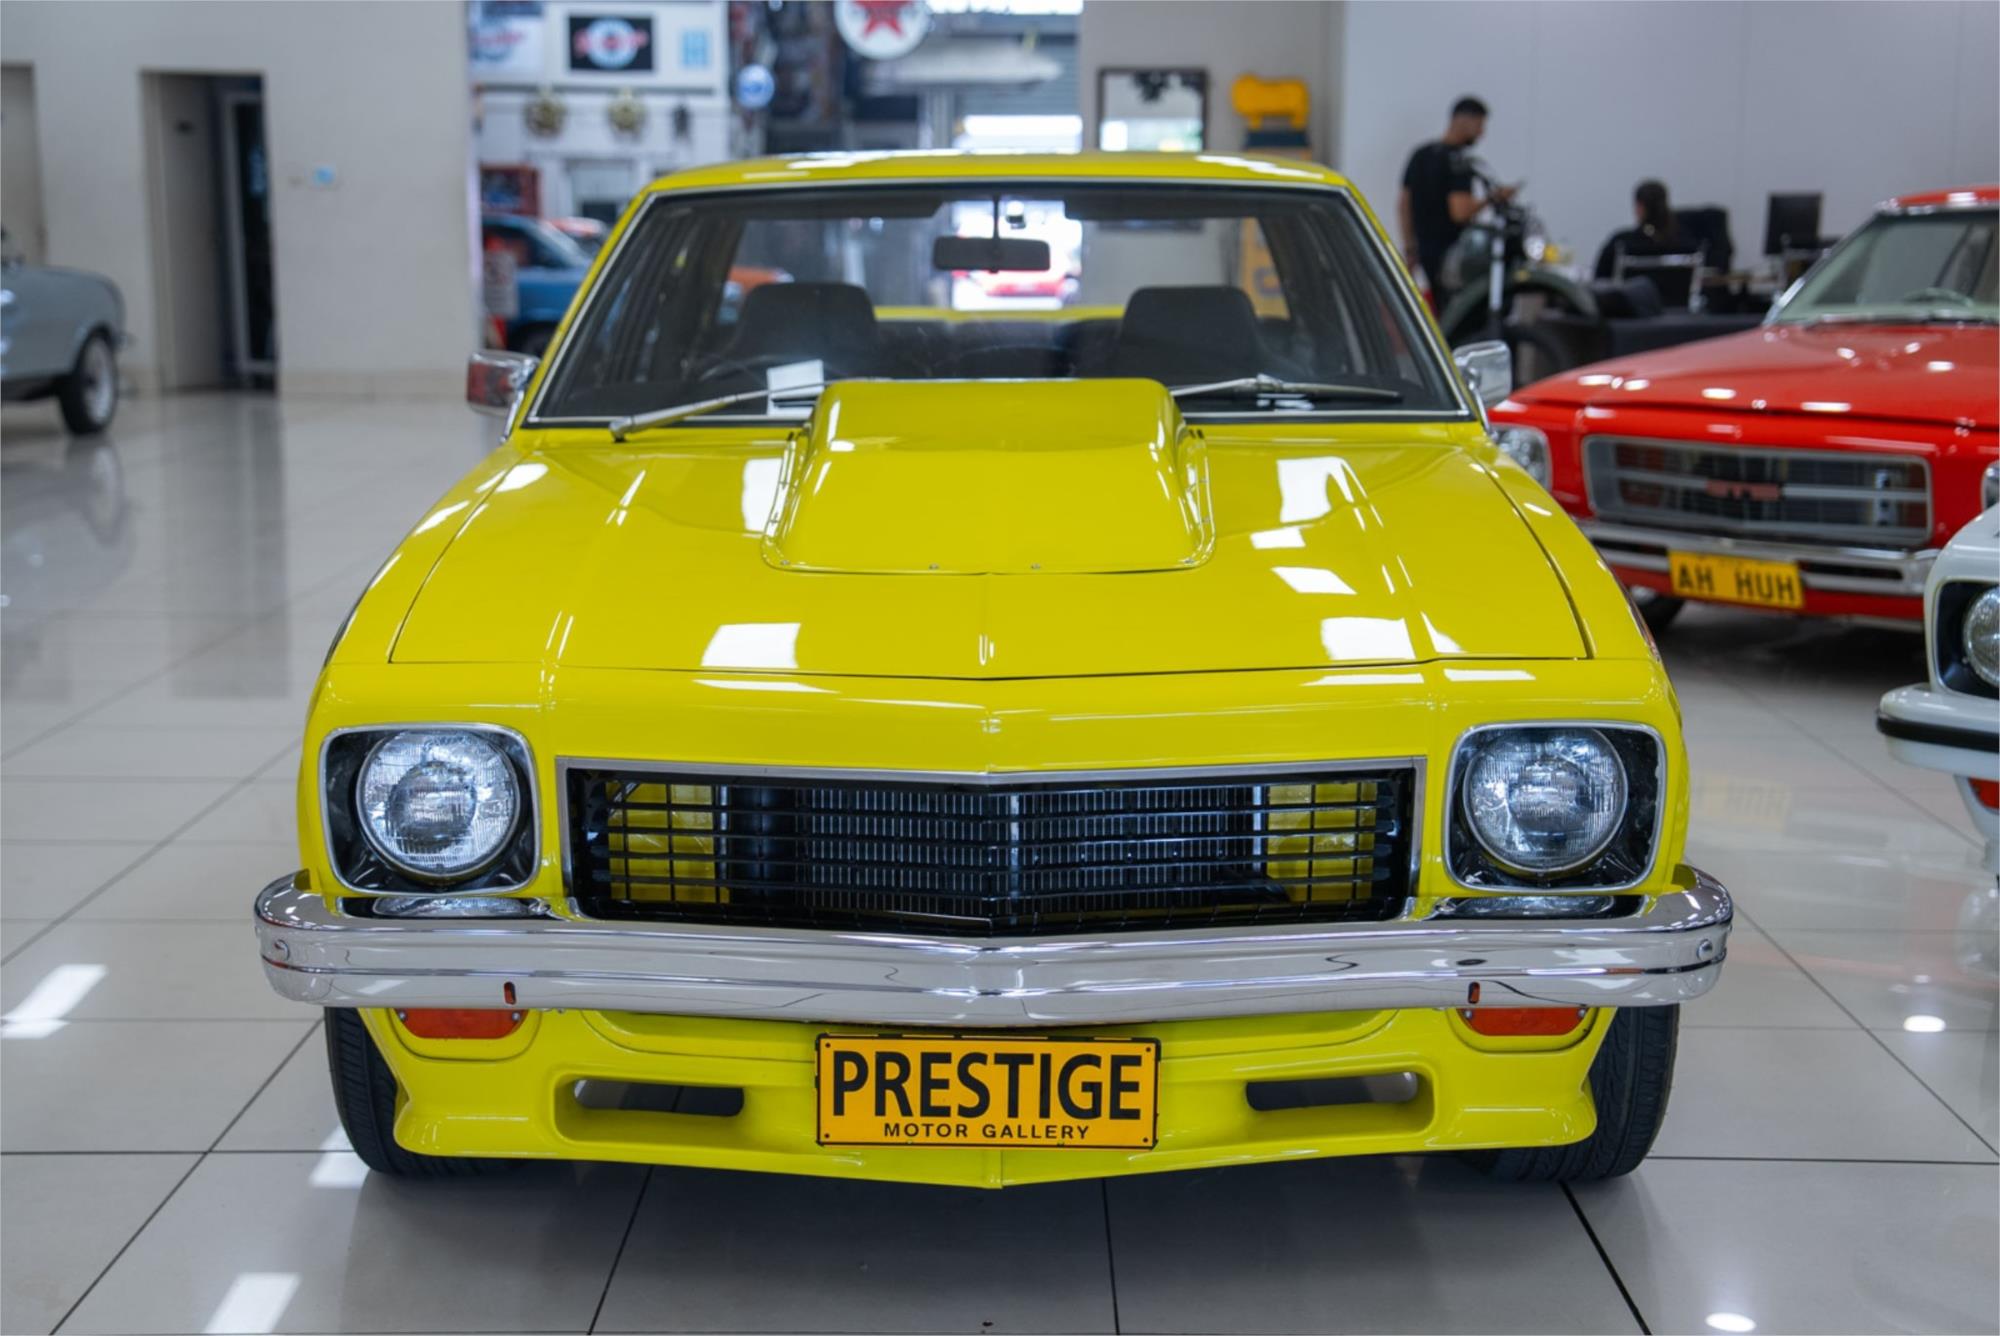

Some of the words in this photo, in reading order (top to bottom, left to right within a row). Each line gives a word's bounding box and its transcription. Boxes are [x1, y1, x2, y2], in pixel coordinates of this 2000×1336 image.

[1678, 563, 1715, 592] AH
[1735, 570, 1795, 602] HUH
[833, 1050, 1143, 1120] PRESTIGE
[884, 1122, 969, 1138] MOTOR
[982, 1124, 1090, 1140] GALLERY
